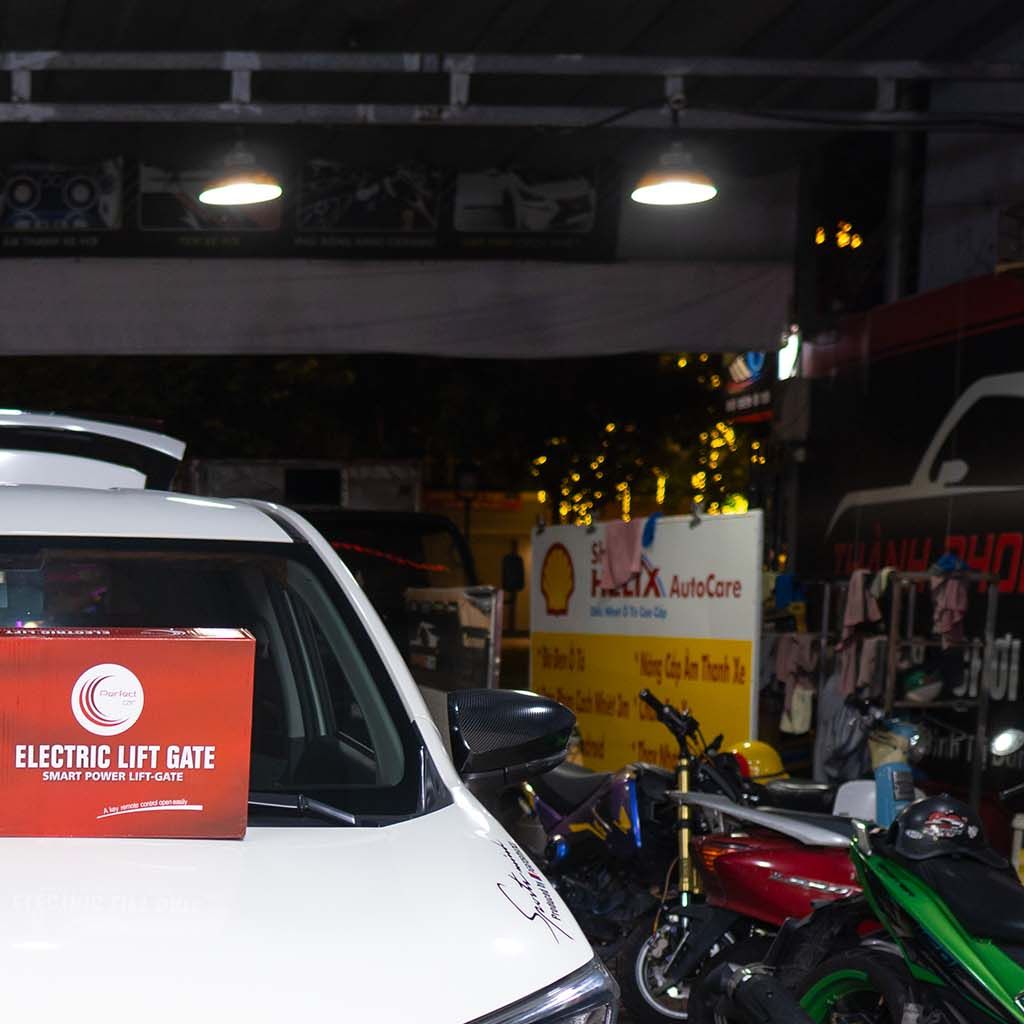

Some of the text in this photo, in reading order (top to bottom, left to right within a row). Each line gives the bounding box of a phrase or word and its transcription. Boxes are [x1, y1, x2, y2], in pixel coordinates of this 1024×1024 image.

[944, 531, 1024, 593] PHO
[670, 572, 742, 599] AutoCare
[701, 653, 730, 682] Thanh
[733, 656, 746, 685] Xe
[15, 744, 216, 769] ELECTRIC LIFT GATE
[42, 771, 184, 783] SMART POWER LIFT-GATE
[120, 802, 139, 811] remote
[140, 799, 158, 808] control
